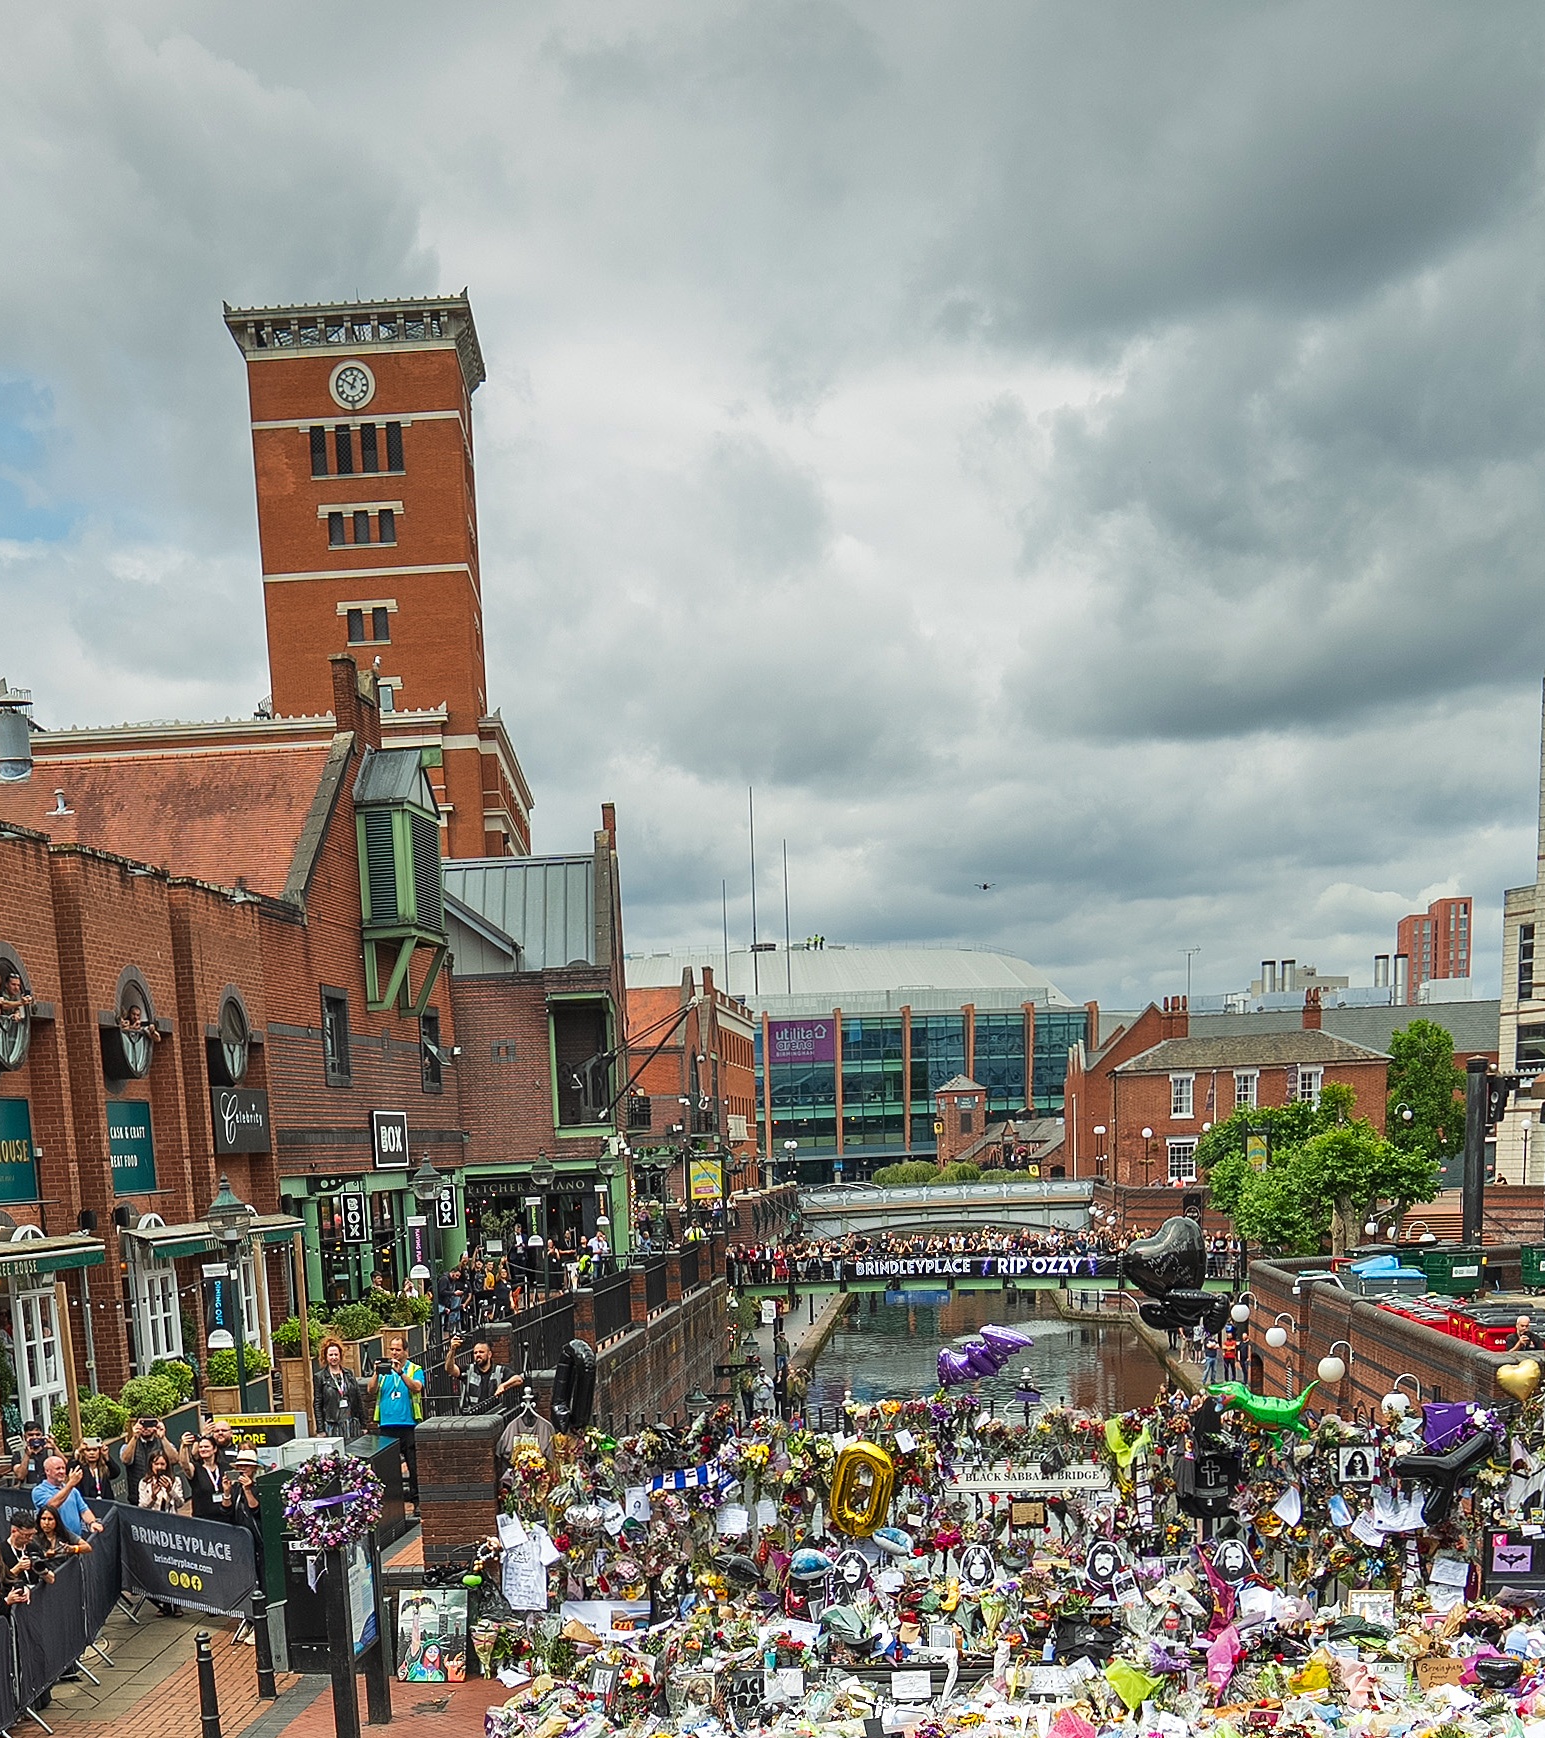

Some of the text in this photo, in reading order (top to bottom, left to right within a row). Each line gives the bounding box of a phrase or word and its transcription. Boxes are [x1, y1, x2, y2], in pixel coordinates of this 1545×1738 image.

[775, 1029, 814, 1041] utilita
[775, 1041, 814, 1051] arena
[220, 1092, 262, 1145] Celebrity
[130, 1127, 145, 1138] CRAFT
[380, 1126, 403, 1153] BOX
[110, 1155, 138, 1167] REAT FOOD
[550, 1180, 585, 1191] IANO
[347, 1198, 360, 1238] BOX
[14, 1260, 38, 1276] HOUSE
[856, 1257, 1082, 1276] BRINDLEYPLACE RIP OZZY
[214, 1281, 224, 1308] DINING
[215, 1309, 224, 1326] OUT
[232, 1433, 267, 1445] PLORE
[965, 1470, 1100, 1482] BLACK BRIDGE
[131, 1524, 233, 1562] BRINDLEYPLACE
[153, 1552, 214, 1574] brindleyplace.com
[612, 1620, 635, 1631] OZZY
